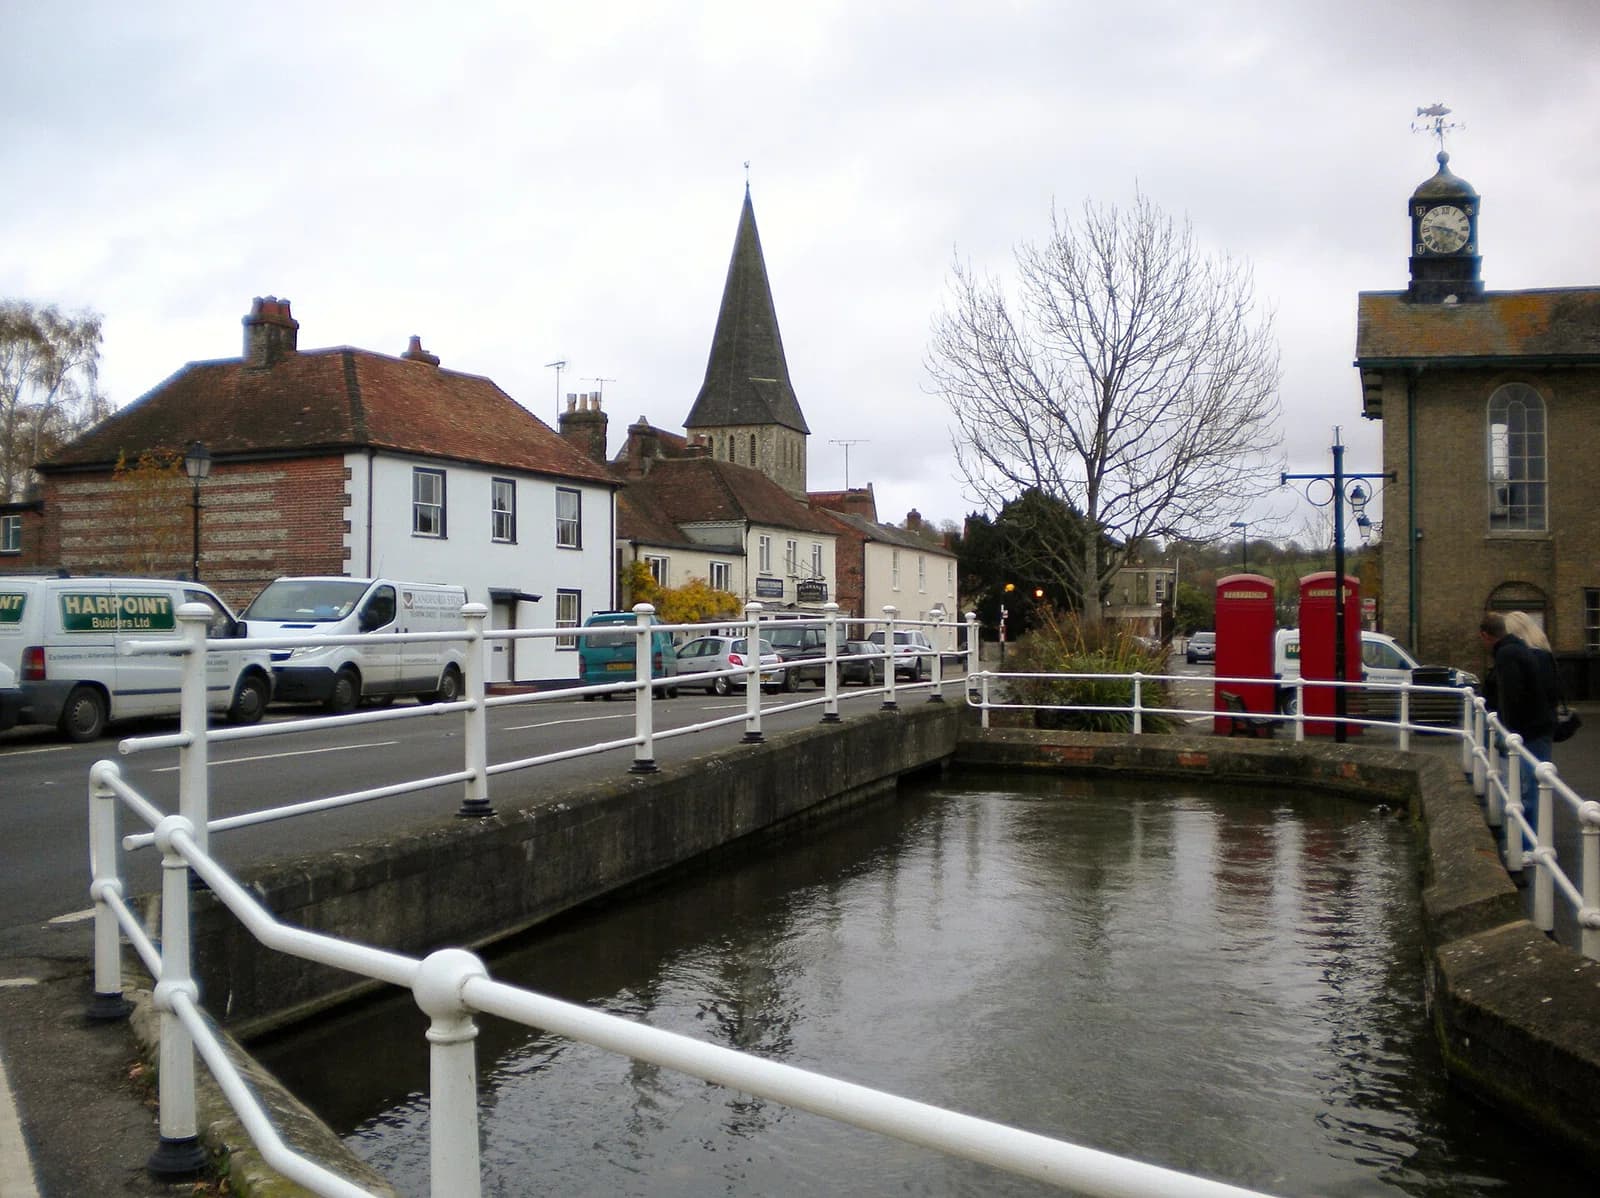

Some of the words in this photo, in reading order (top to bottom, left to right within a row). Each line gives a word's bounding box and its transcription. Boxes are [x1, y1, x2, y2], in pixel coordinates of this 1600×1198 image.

[64, 596, 169, 614] HARPOINT
[92, 617, 133, 629] Builders
[135, 617, 150, 628] Ltd
